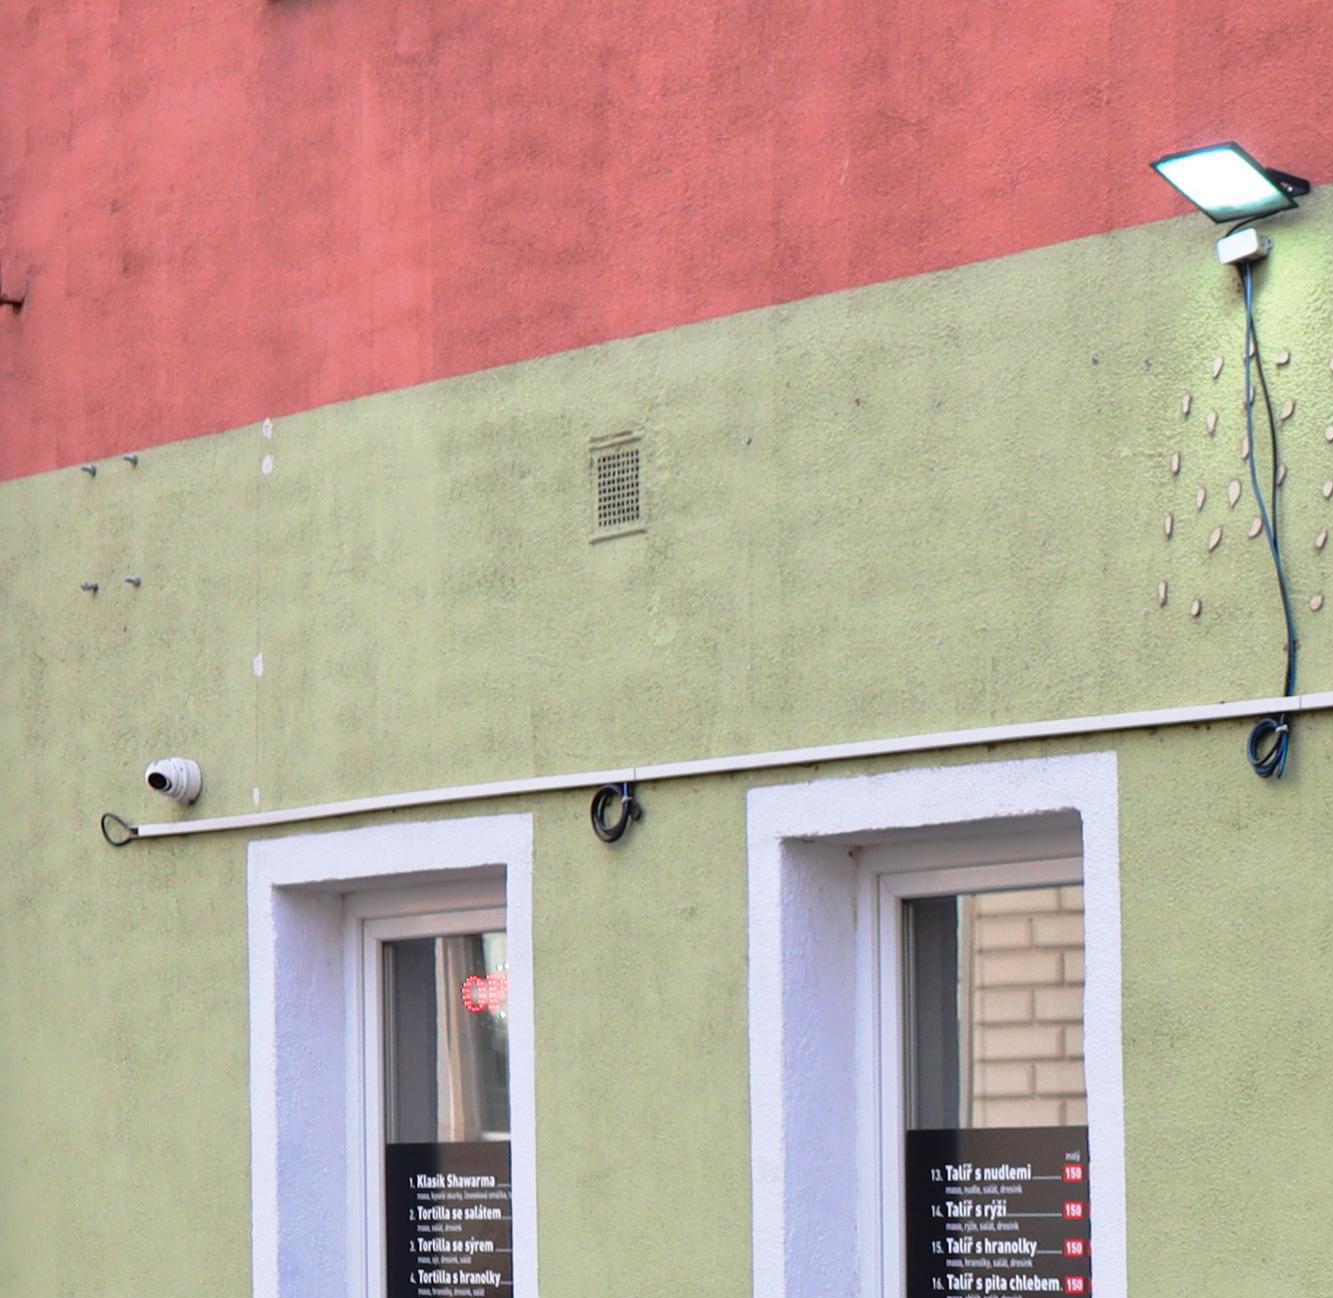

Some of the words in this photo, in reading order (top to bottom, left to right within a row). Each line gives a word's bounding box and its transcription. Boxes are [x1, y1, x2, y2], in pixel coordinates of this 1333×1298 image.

[416, 1173, 446, 1189] Klasik
[447, 1173, 496, 1188] Shawarma
[945, 1163, 972, 1181] Talíř
[984, 1163, 1032, 1181] nudlemi
[1065, 1166, 1082, 1180] 150
[417, 1205, 450, 1220] Tortilla
[452, 1208, 462, 1220] se
[464, 1204, 501, 1220] salátem
[946, 1199, 973, 1217] Talíř
[984, 1199, 1007, 1220] rýží
[1065, 1203, 1082, 1218] 150
[417, 1237, 450, 1252] Tortilla
[453, 1240, 462, 1252] se
[465, 1236, 494, 1255] sýrem
[946, 1236, 973, 1254] Talíř
[984, 1237, 1037, 1257] hranolky
[1066, 1241, 1083, 1255] 150
[418, 1269, 451, 1284] Tortilla
[460, 1270, 501, 1288] hranolky
[947, 1272, 974, 1290] Talíř
[985, 1275, 1007, 1294] pita
[1009, 1275, 1060, 1291] chlebem
[1066, 1278, 1084, 1292] 150
